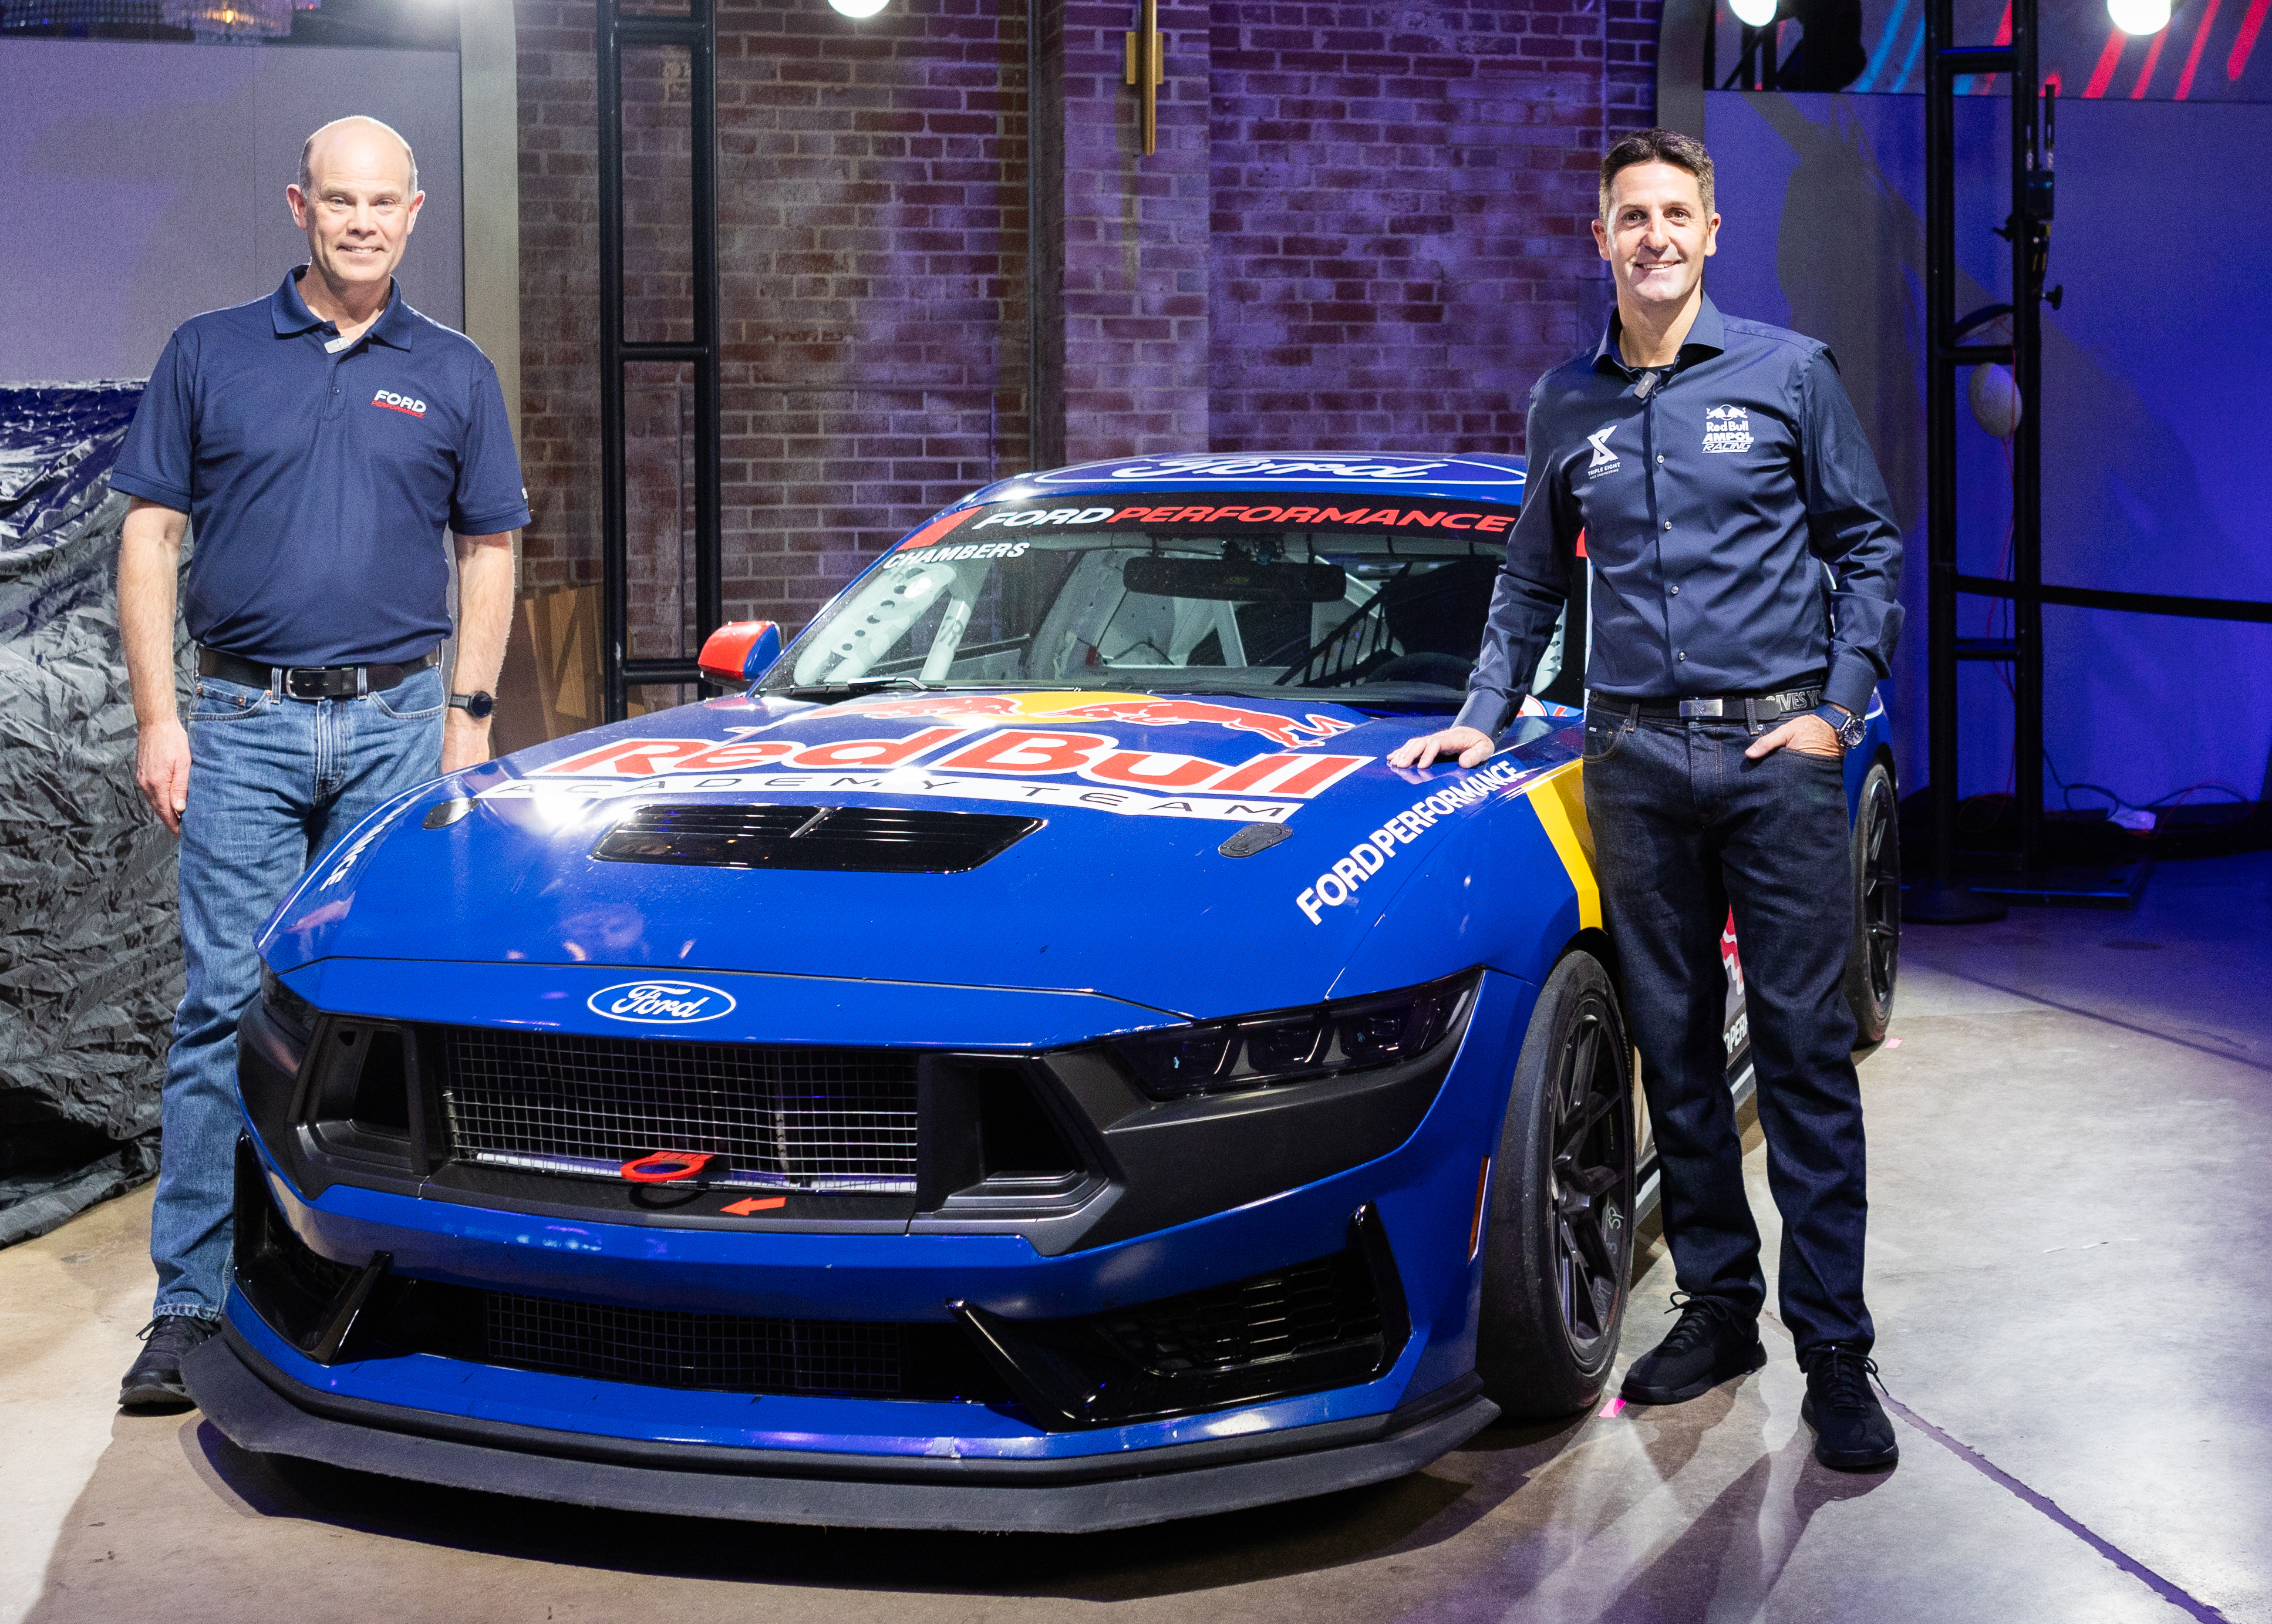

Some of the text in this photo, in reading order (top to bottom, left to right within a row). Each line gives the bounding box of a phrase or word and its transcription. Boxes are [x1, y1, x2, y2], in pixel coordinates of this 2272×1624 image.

[371, 400, 424, 419] PERFORMANCE
[374, 389, 426, 413] FORD
[1703, 432, 1754, 442] AMPOL
[1706, 420, 1749, 432] Red Bull
[1703, 442, 1751, 452] RACING
[1111, 456, 1449, 478] Ford
[1587, 462, 1621, 476] TRIPLE EIGHT
[883, 543, 1030, 569] CHAMBERS
[537, 728, 1368, 795] Red Bull
[496, 777, 1286, 818] ACADEMY TEAM
[611, 985, 710, 1018] Ford
